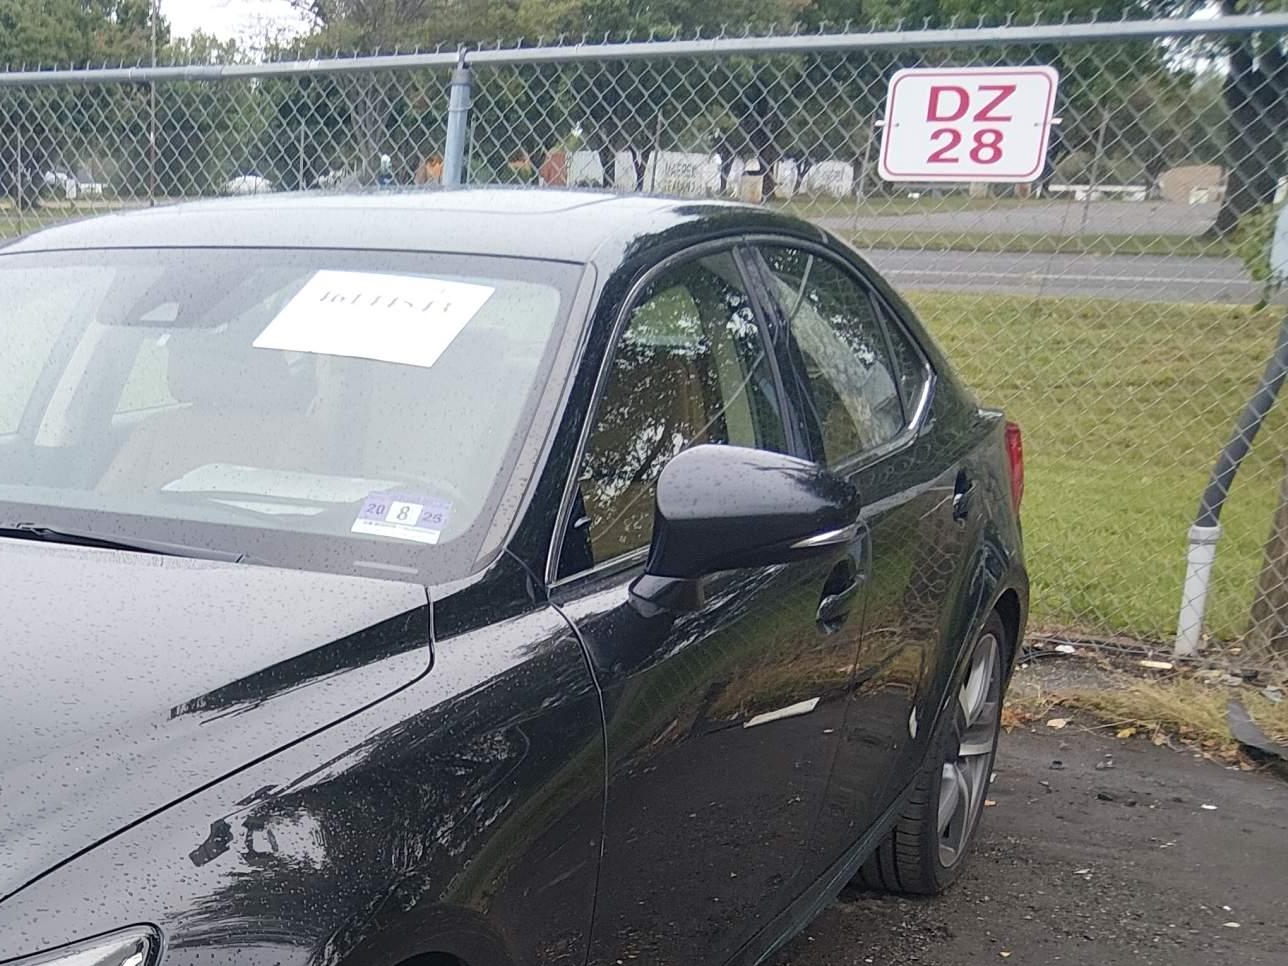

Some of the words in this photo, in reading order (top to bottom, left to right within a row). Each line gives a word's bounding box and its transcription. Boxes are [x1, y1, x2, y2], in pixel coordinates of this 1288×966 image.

[926, 84, 1017, 123] DZ
[926, 127, 1004, 164] 28
[366, 503, 386, 515] 20
[396, 505, 410, 521] 8
